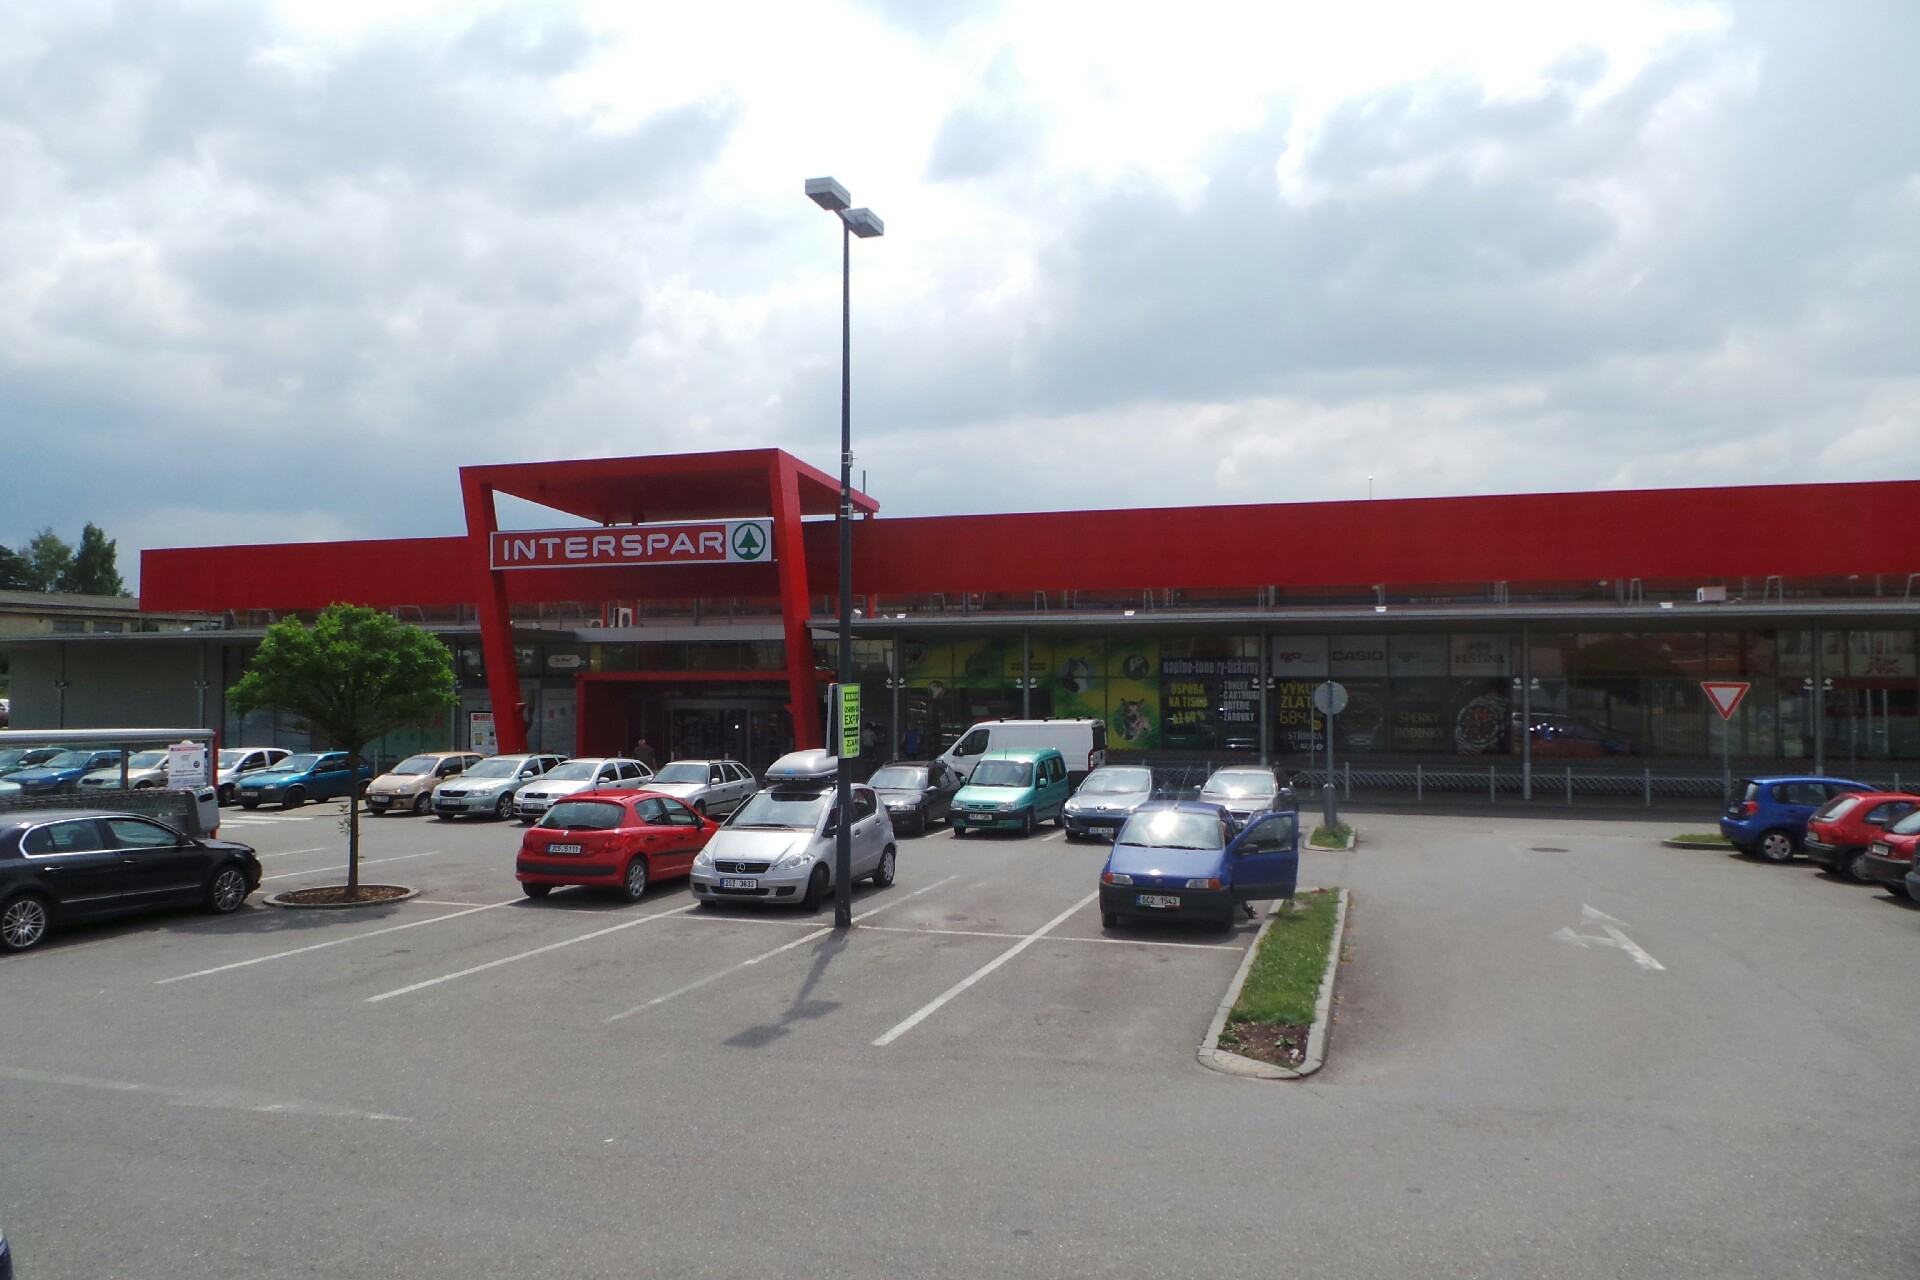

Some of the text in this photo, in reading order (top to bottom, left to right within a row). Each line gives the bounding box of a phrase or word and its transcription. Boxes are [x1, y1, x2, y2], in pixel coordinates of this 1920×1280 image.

[503, 531, 724, 560] INTERSPAR
[1333, 651, 1384, 661] CASIO
[1455, 654, 1505, 664] FESTINA
